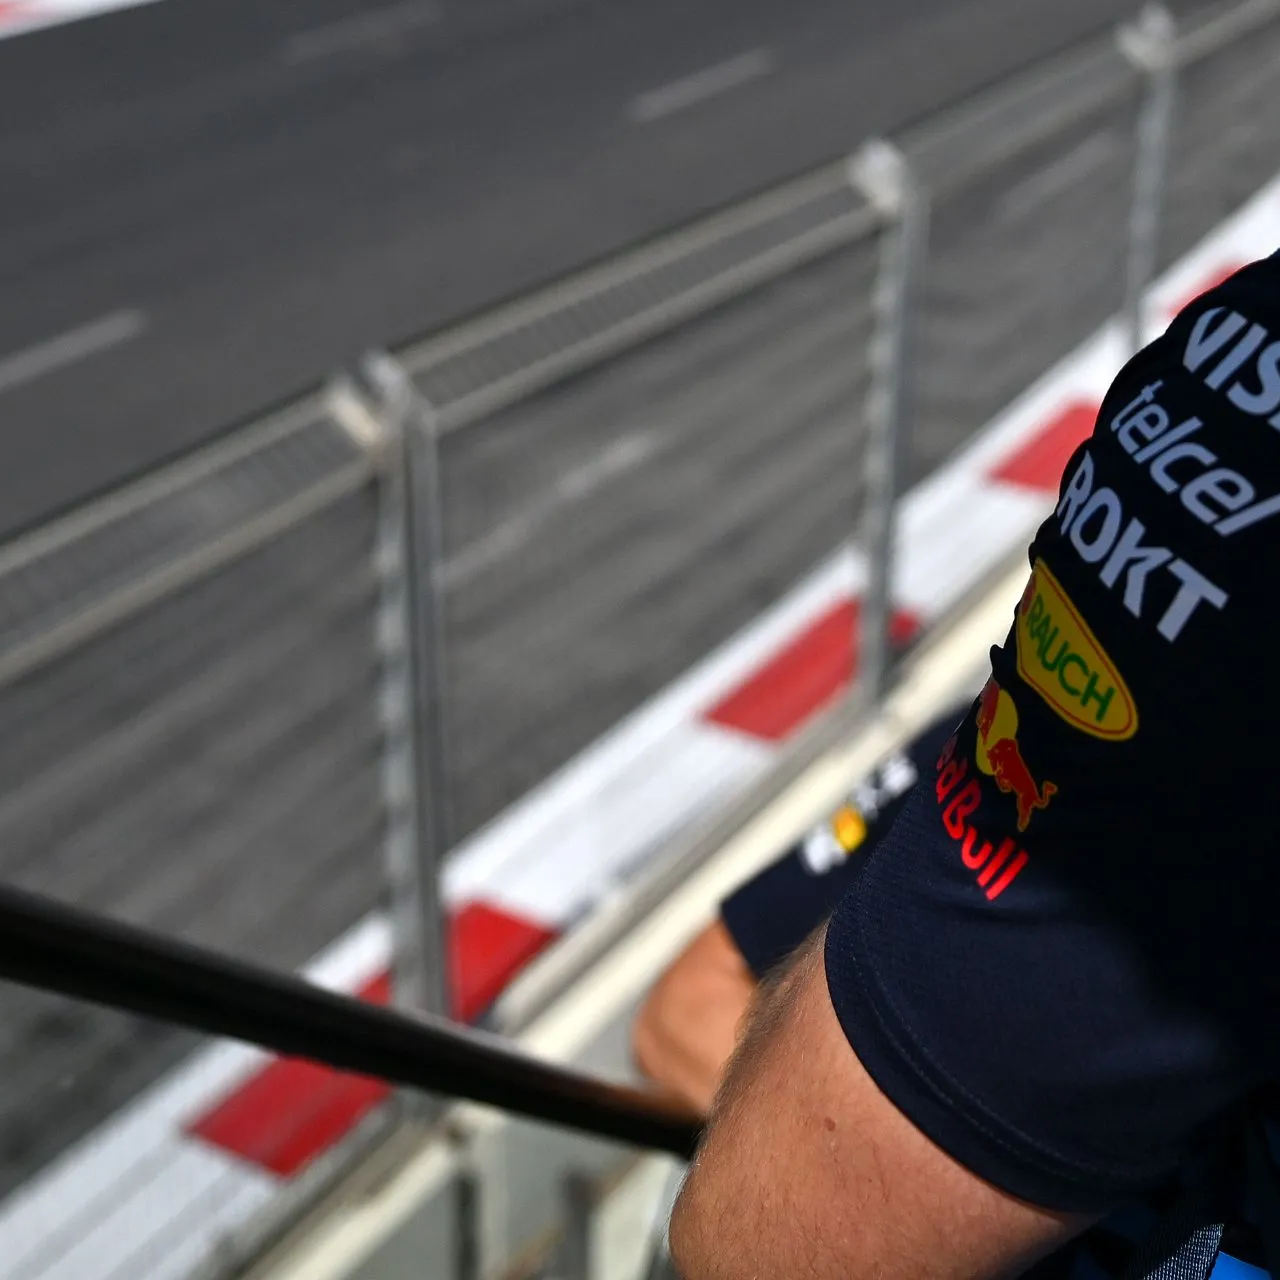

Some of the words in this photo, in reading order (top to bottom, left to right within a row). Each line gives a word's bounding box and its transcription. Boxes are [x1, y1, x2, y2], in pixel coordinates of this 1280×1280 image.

[1056, 450, 1228, 643] ROKT
[1026, 591, 1117, 724] RAUCH
[942, 778, 1029, 902] Bull
